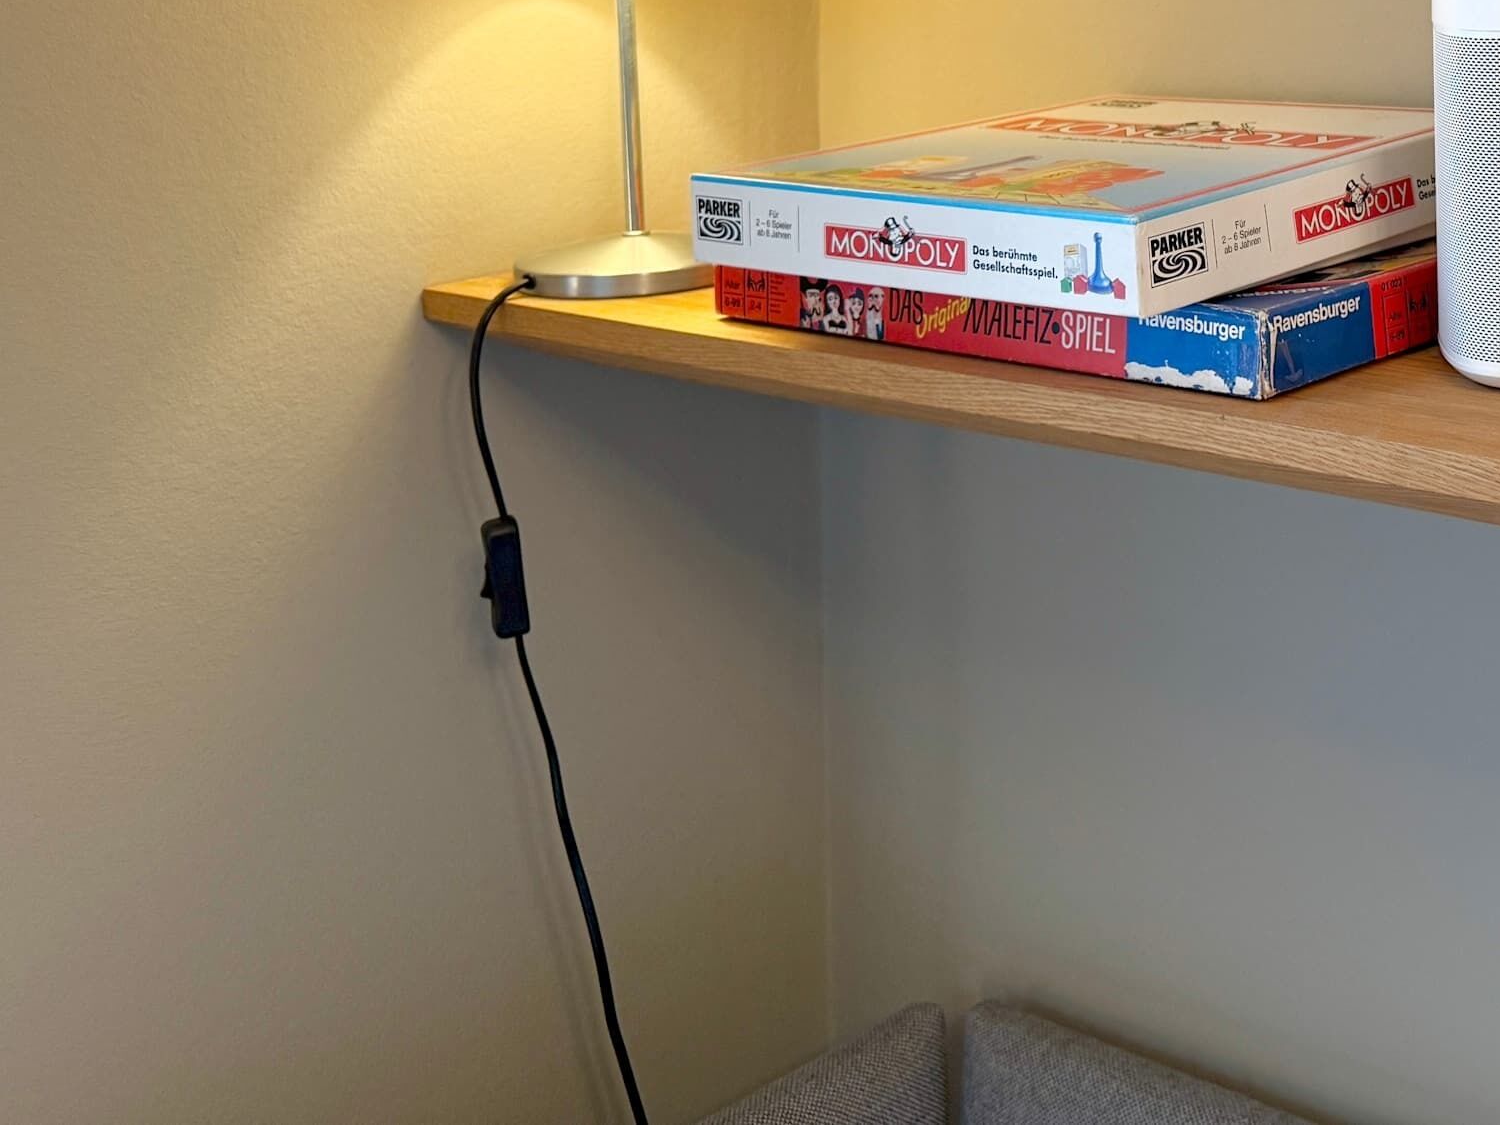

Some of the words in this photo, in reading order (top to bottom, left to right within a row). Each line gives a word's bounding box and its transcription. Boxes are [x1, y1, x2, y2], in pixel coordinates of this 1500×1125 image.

[698, 198, 740, 218] PARKER
[1301, 181, 1408, 236] MONOPOLY
[1234, 219, 1246, 230] Für
[1239, 226, 1262, 240] Spieler
[830, 229, 960, 268] MONOPOLY
[1150, 226, 1203, 258] PARKER
[1224, 244, 1233, 255] ab
[1239, 236, 1262, 250] Jahren
[972, 245, 990, 257] Das
[992, 245, 1038, 263] berühmte
[972, 259, 1058, 280] Gesellschaftsspiel.
[889, 287, 924, 325] DAS
[963, 298, 1055, 345] MALEFIZ
[1061, 311, 1116, 354] SPIEL
[1273, 295, 1361, 335] Ravensburger
